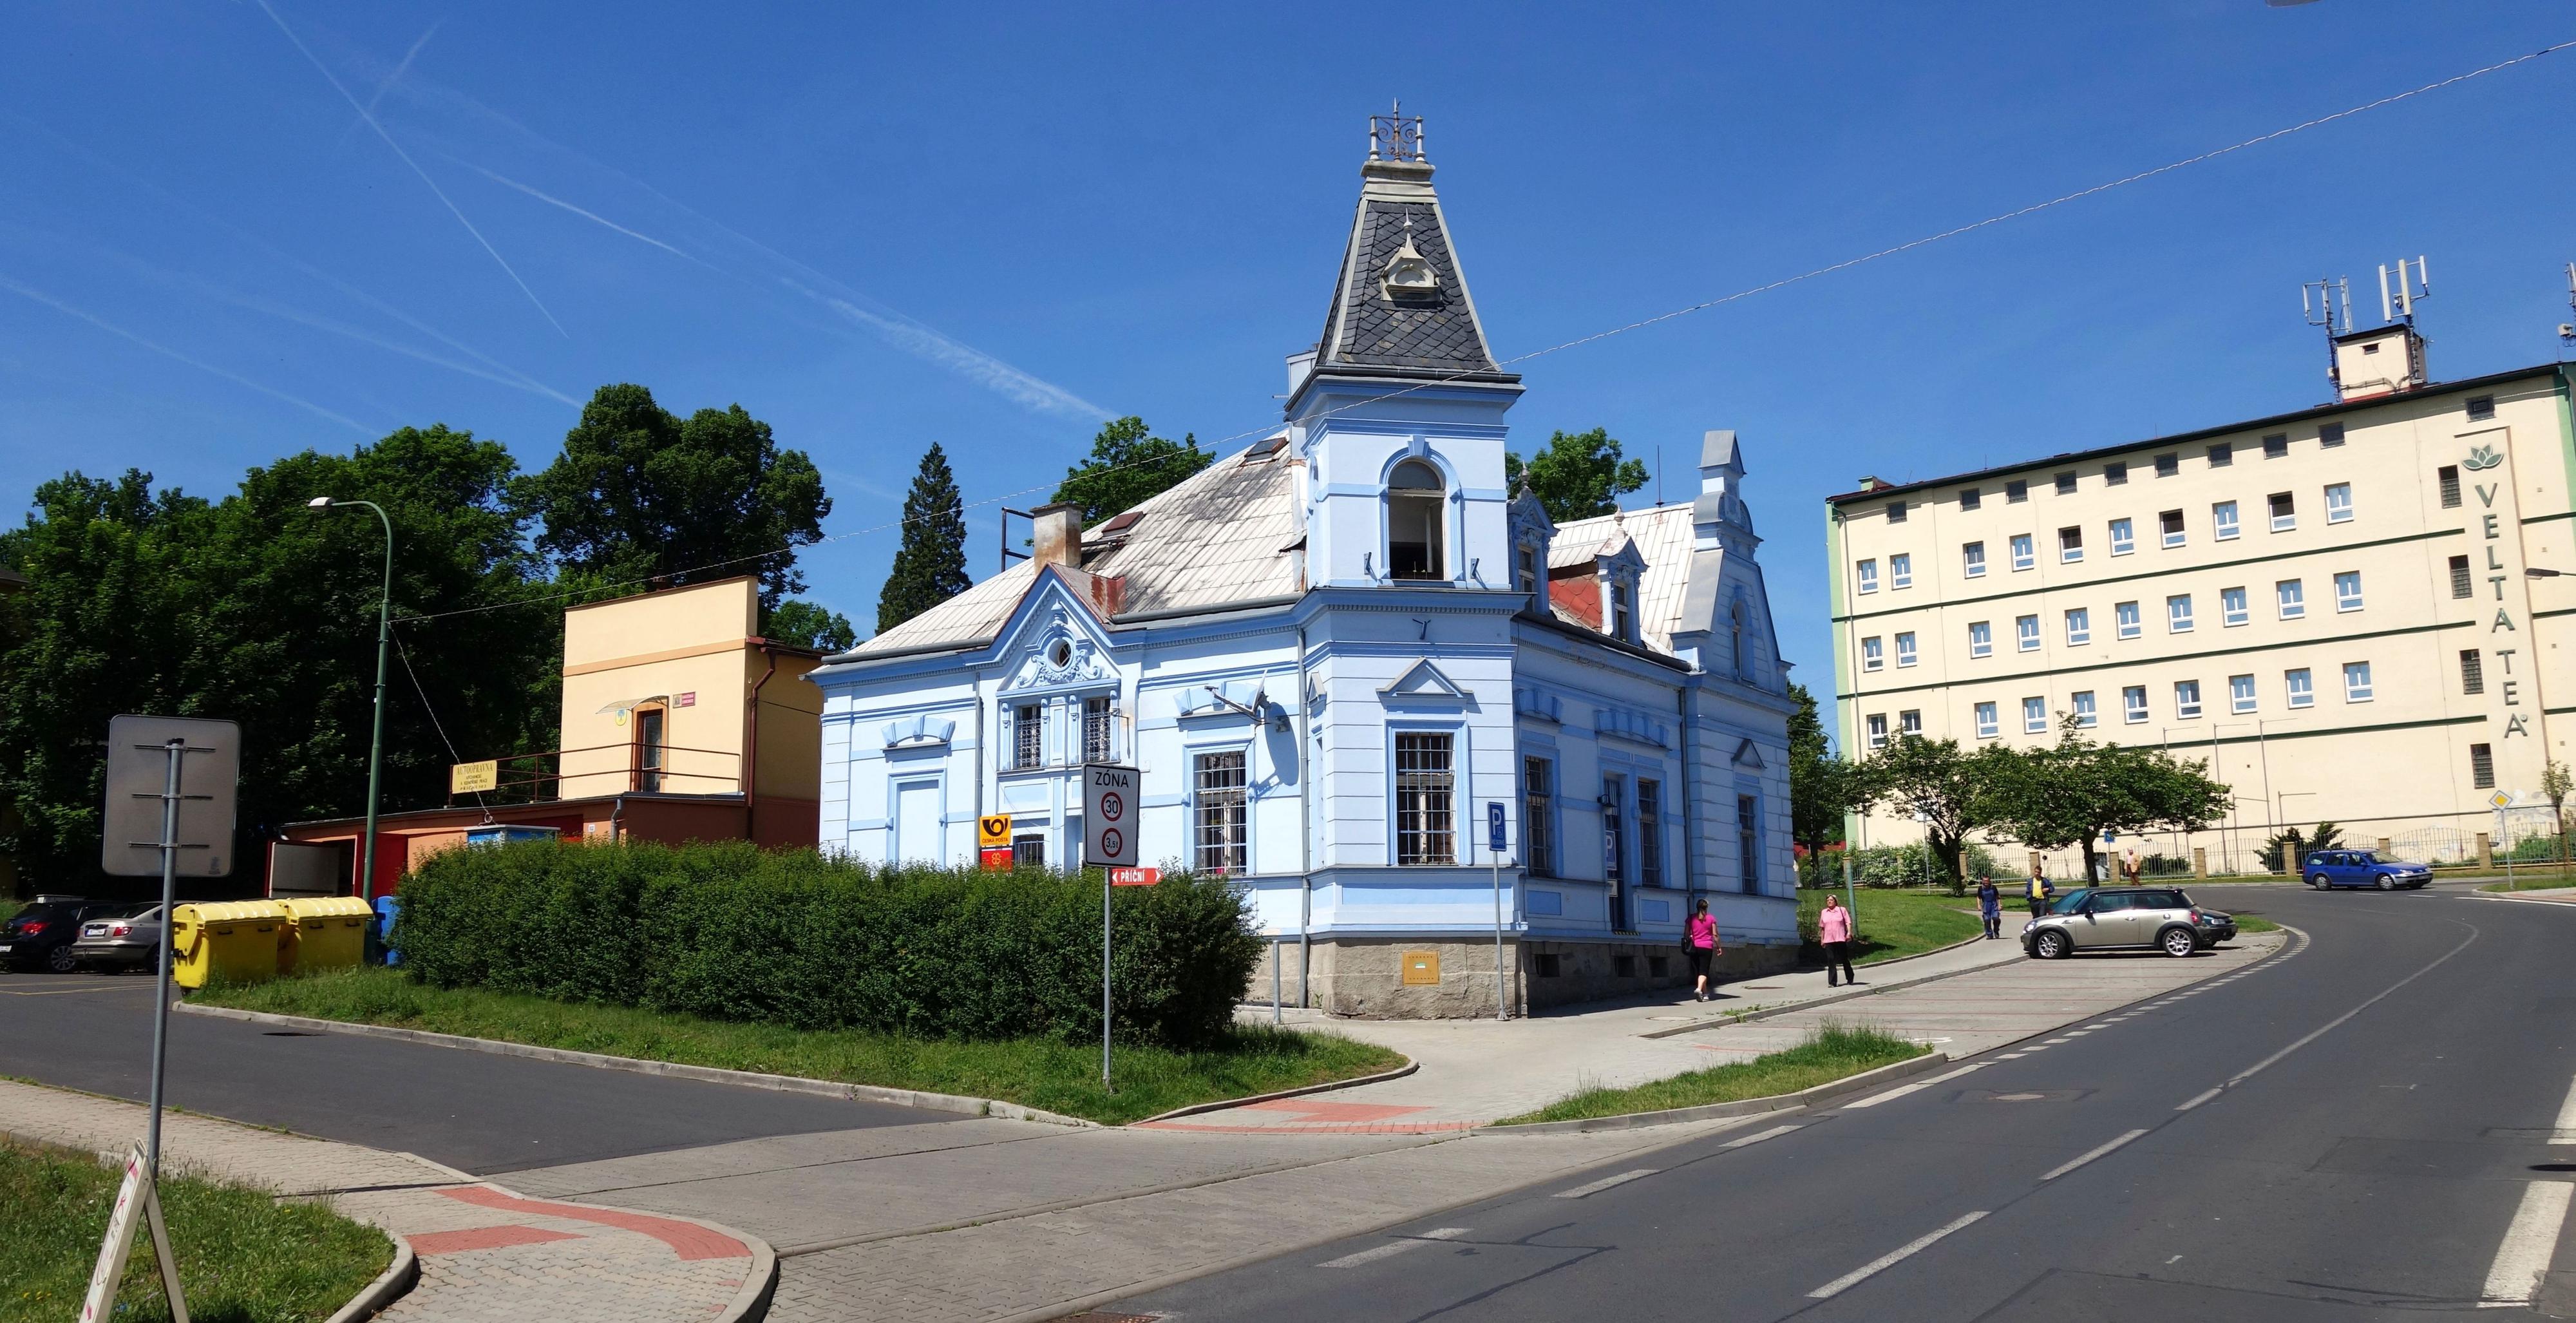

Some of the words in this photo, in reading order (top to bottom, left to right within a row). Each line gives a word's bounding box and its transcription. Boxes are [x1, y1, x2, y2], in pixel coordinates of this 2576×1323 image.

[457, 763, 493, 775] AUTOOPRAVNA
[1095, 770, 1129, 788] ZÓNA
[1105, 799, 1119, 814] 30
[1492, 808, 1502, 835] P
[1121, 868, 1145, 882] PŘÍČNÍ
